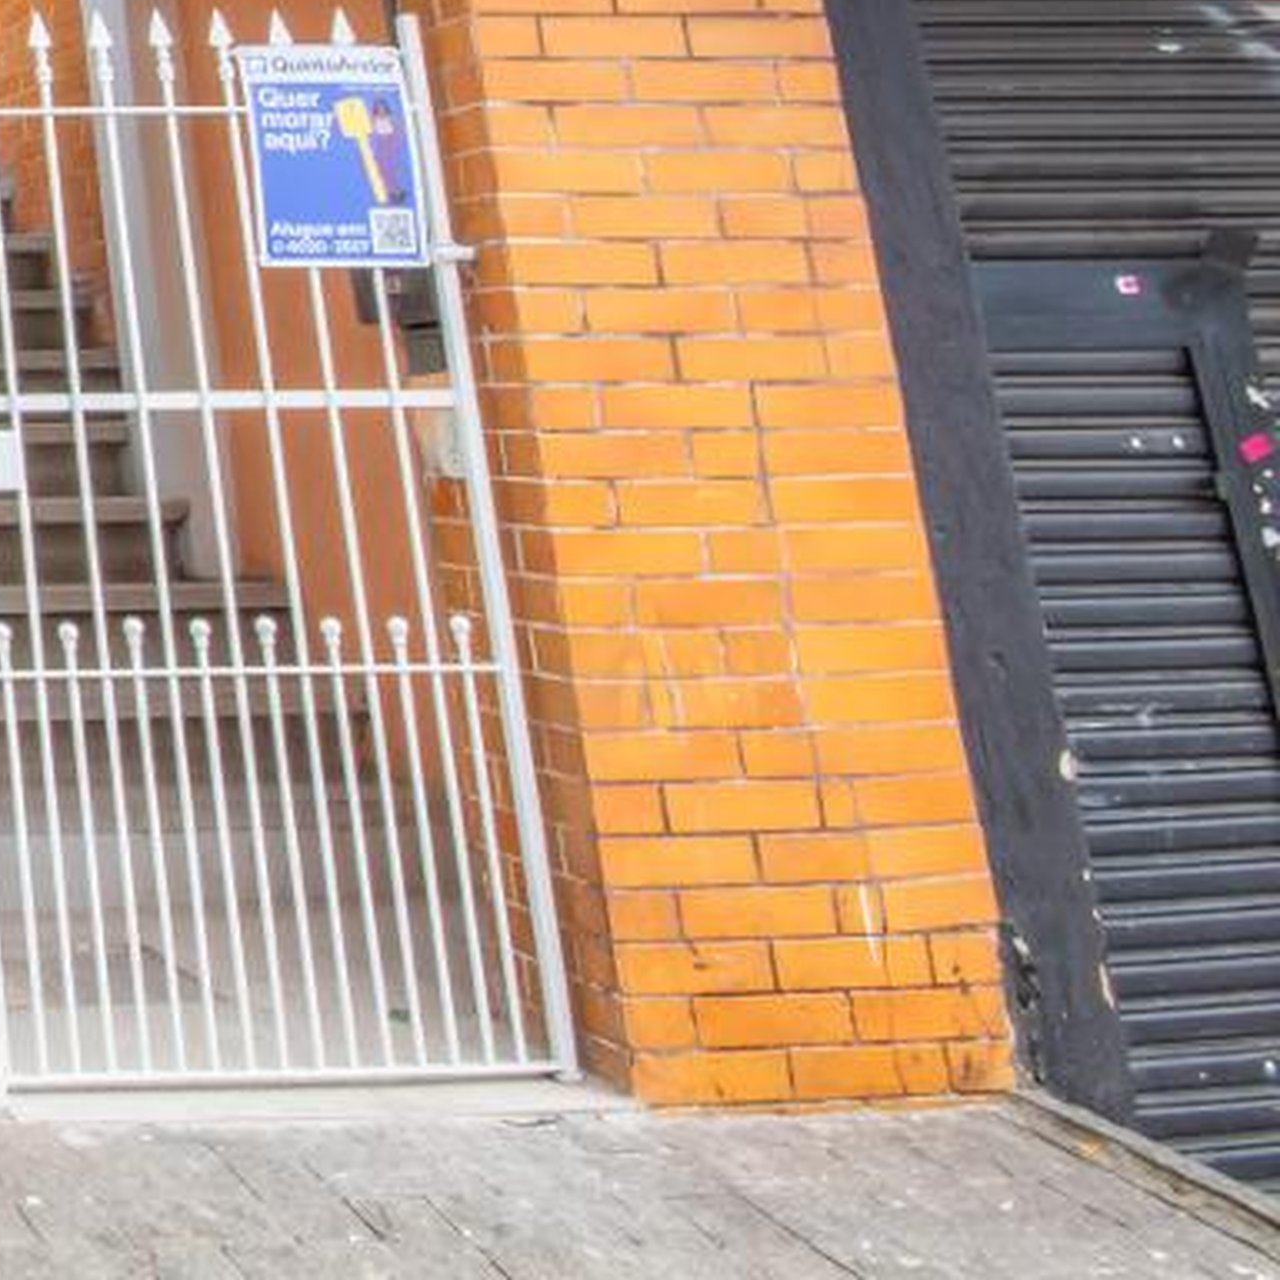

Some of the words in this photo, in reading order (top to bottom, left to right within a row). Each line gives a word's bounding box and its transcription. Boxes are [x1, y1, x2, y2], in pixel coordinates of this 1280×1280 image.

[258, 87, 321, 108] Quer
[262, 111, 333, 128] morar
[265, 130, 332, 153] aqui?
